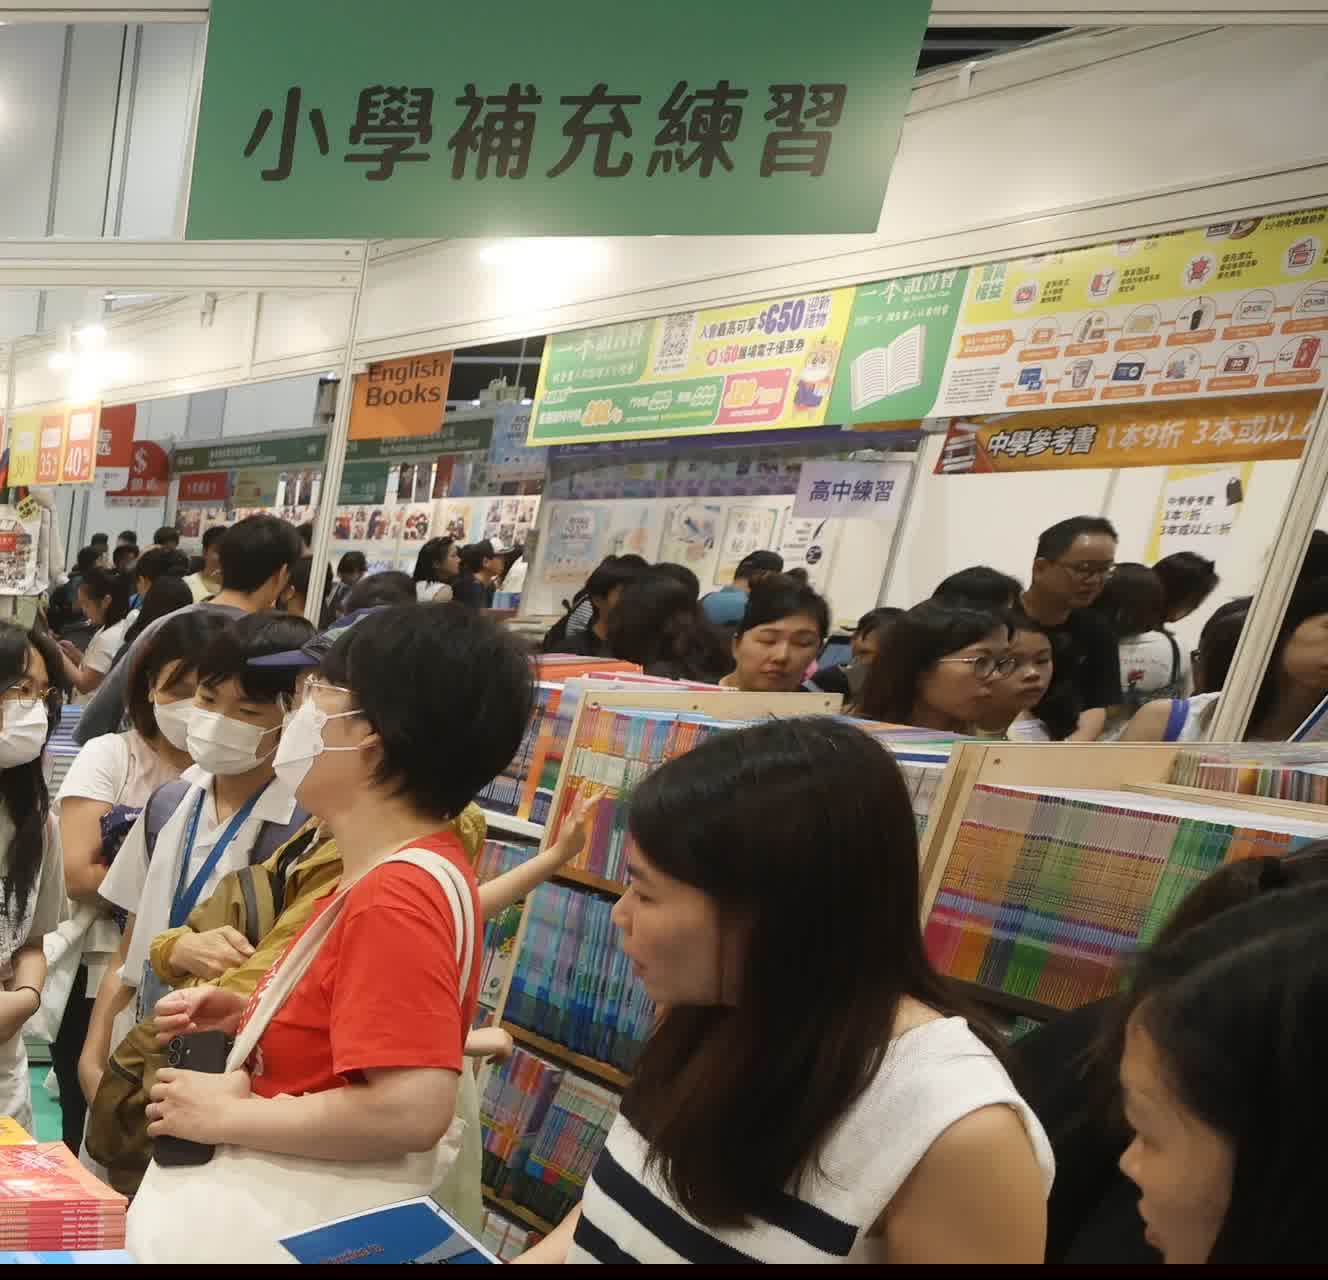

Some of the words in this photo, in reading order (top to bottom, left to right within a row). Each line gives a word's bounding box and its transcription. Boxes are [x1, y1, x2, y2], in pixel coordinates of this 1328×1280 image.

[245, 81, 847, 182] 小學補充練習
[367, 360, 445, 387] English
[365, 384, 441, 407] Books
[987, 423, 1098, 460] 中學參考書
[809, 480, 895, 503] 高中練習
